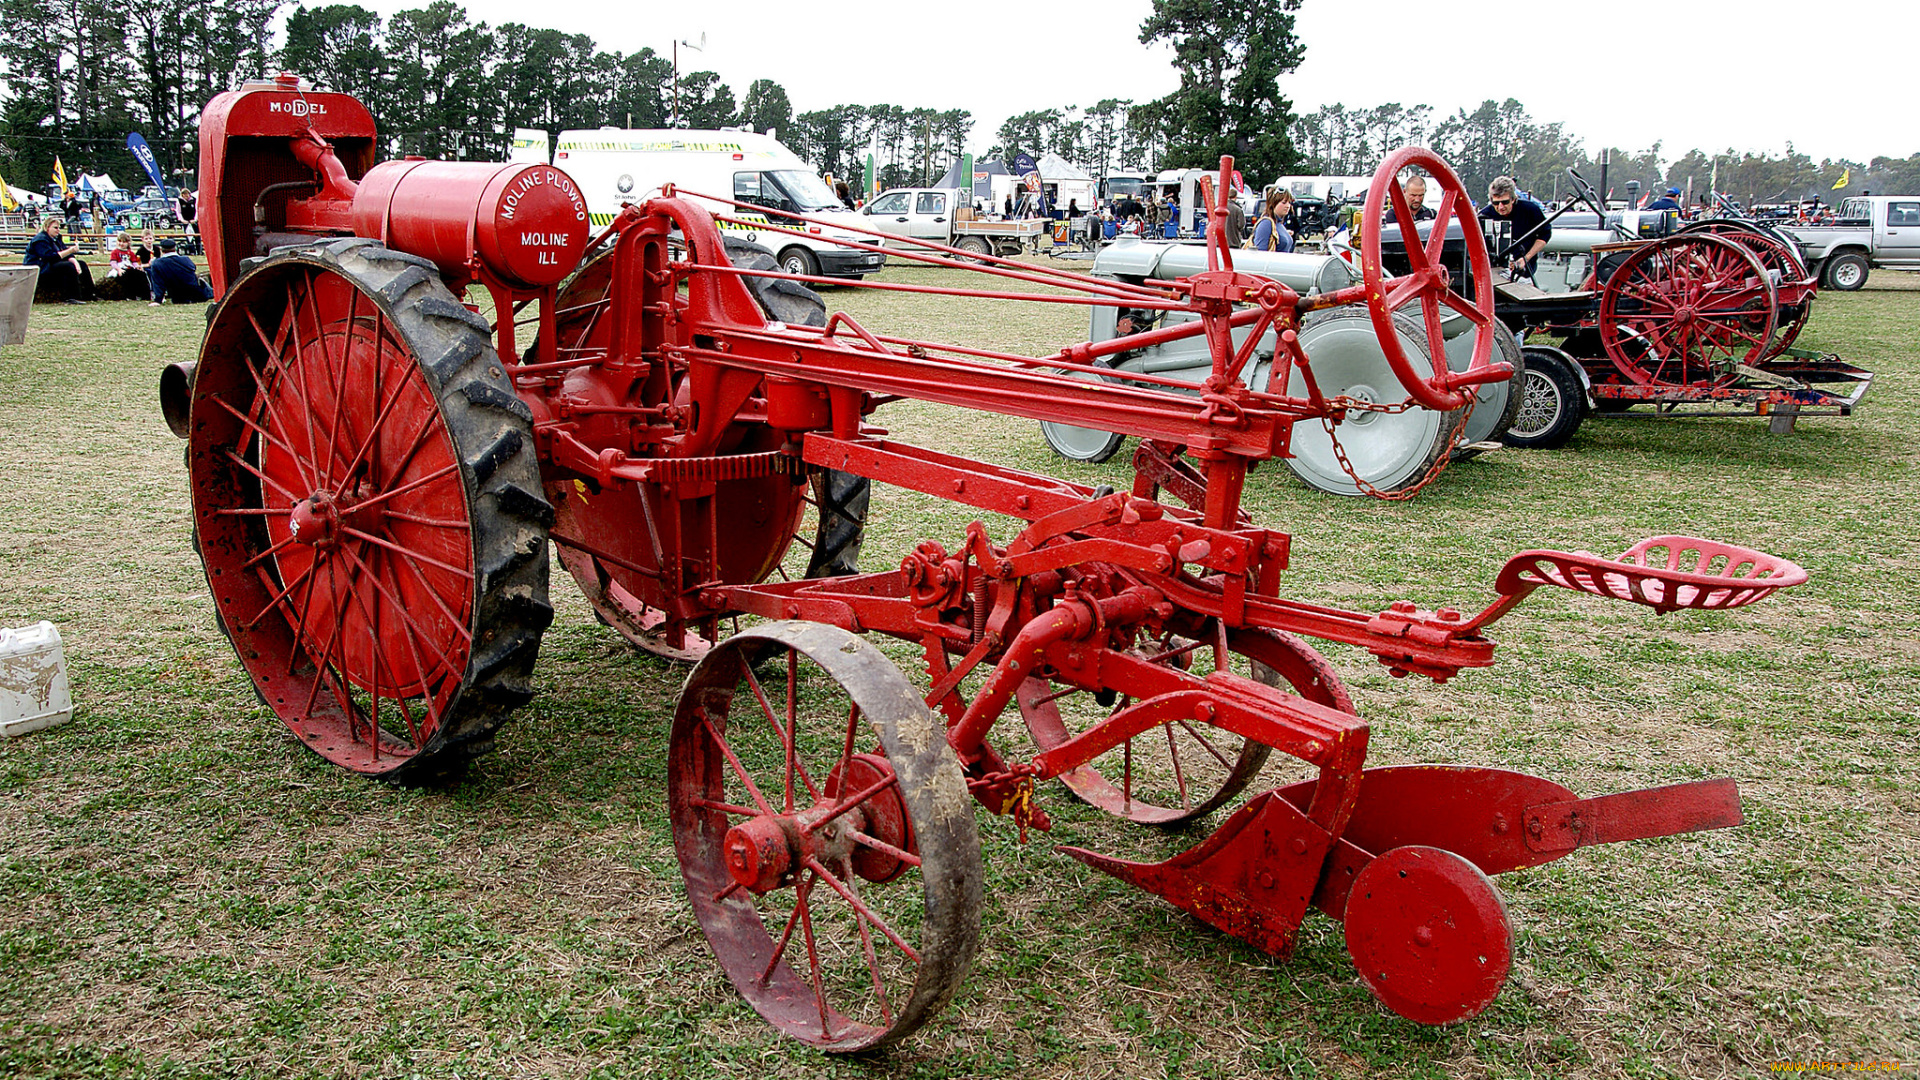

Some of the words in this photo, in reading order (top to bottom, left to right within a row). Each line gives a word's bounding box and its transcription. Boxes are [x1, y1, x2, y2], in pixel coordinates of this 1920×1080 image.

[270, 99, 327, 117] MODEL
[501, 172, 542, 220] MOLINE
[521, 232, 569, 246] MOLINE
[538, 251, 558, 265] ILL
